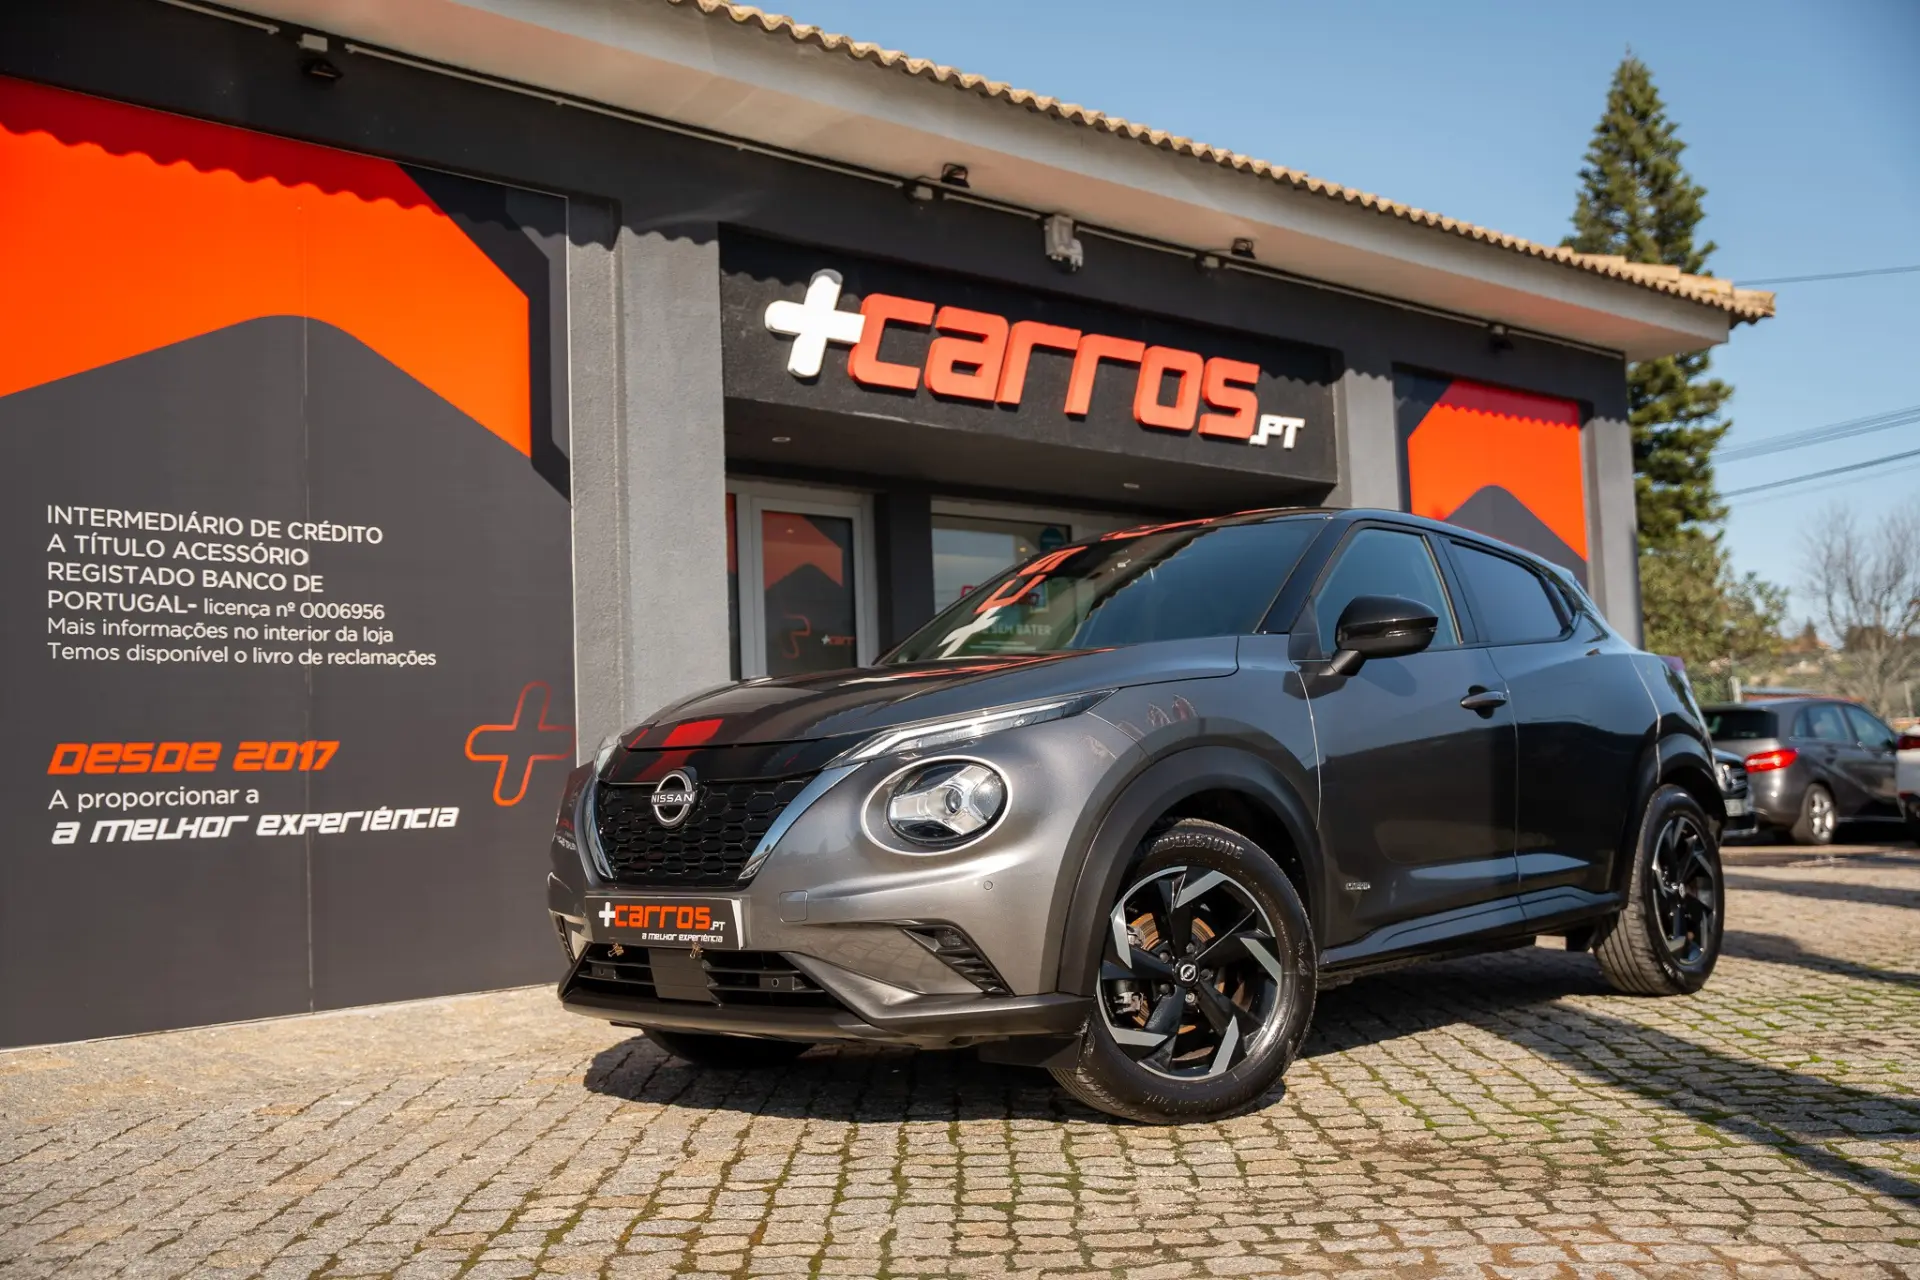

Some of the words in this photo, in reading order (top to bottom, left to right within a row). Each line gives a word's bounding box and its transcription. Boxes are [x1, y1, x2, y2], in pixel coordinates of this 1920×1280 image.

[47, 504, 244, 536] INTERMEDIÁRIO
[250, 519, 282, 539] DE
[287, 520, 384, 544] CRÉDITO
[46, 532, 67, 553] A
[73, 531, 166, 559] TÍTULO
[172, 541, 310, 566] ACESSÓRIO
[47, 561, 195, 587] REGISTADO
[202, 569, 288, 592] BANCO
[293, 574, 325, 593] DE
[47, 589, 198, 614] PORTUGAL-
[203, 597, 271, 619] licença
[47, 617, 96, 636] Mais
[102, 619, 228, 641] informações
[233, 625, 259, 640] no
[263, 624, 331, 642] interior
[334, 626, 359, 642] da
[363, 626, 394, 645] loja
[47, 642, 121, 661] Temos
[126, 644, 229, 665] disponível
[233, 650, 248, 664] o
[252, 647, 294, 665] livro
[298, 648, 324, 665] de
[327, 649, 437, 667] reclamações
[232, 740, 341, 772] 2017
[48, 789, 70, 810] A
[77, 786, 240, 813] proporcionar
[245, 788, 260, 804] a
[651, 793, 693, 803] NISSAN
[51, 821, 81, 845] a
[641, 932, 647, 940] a
